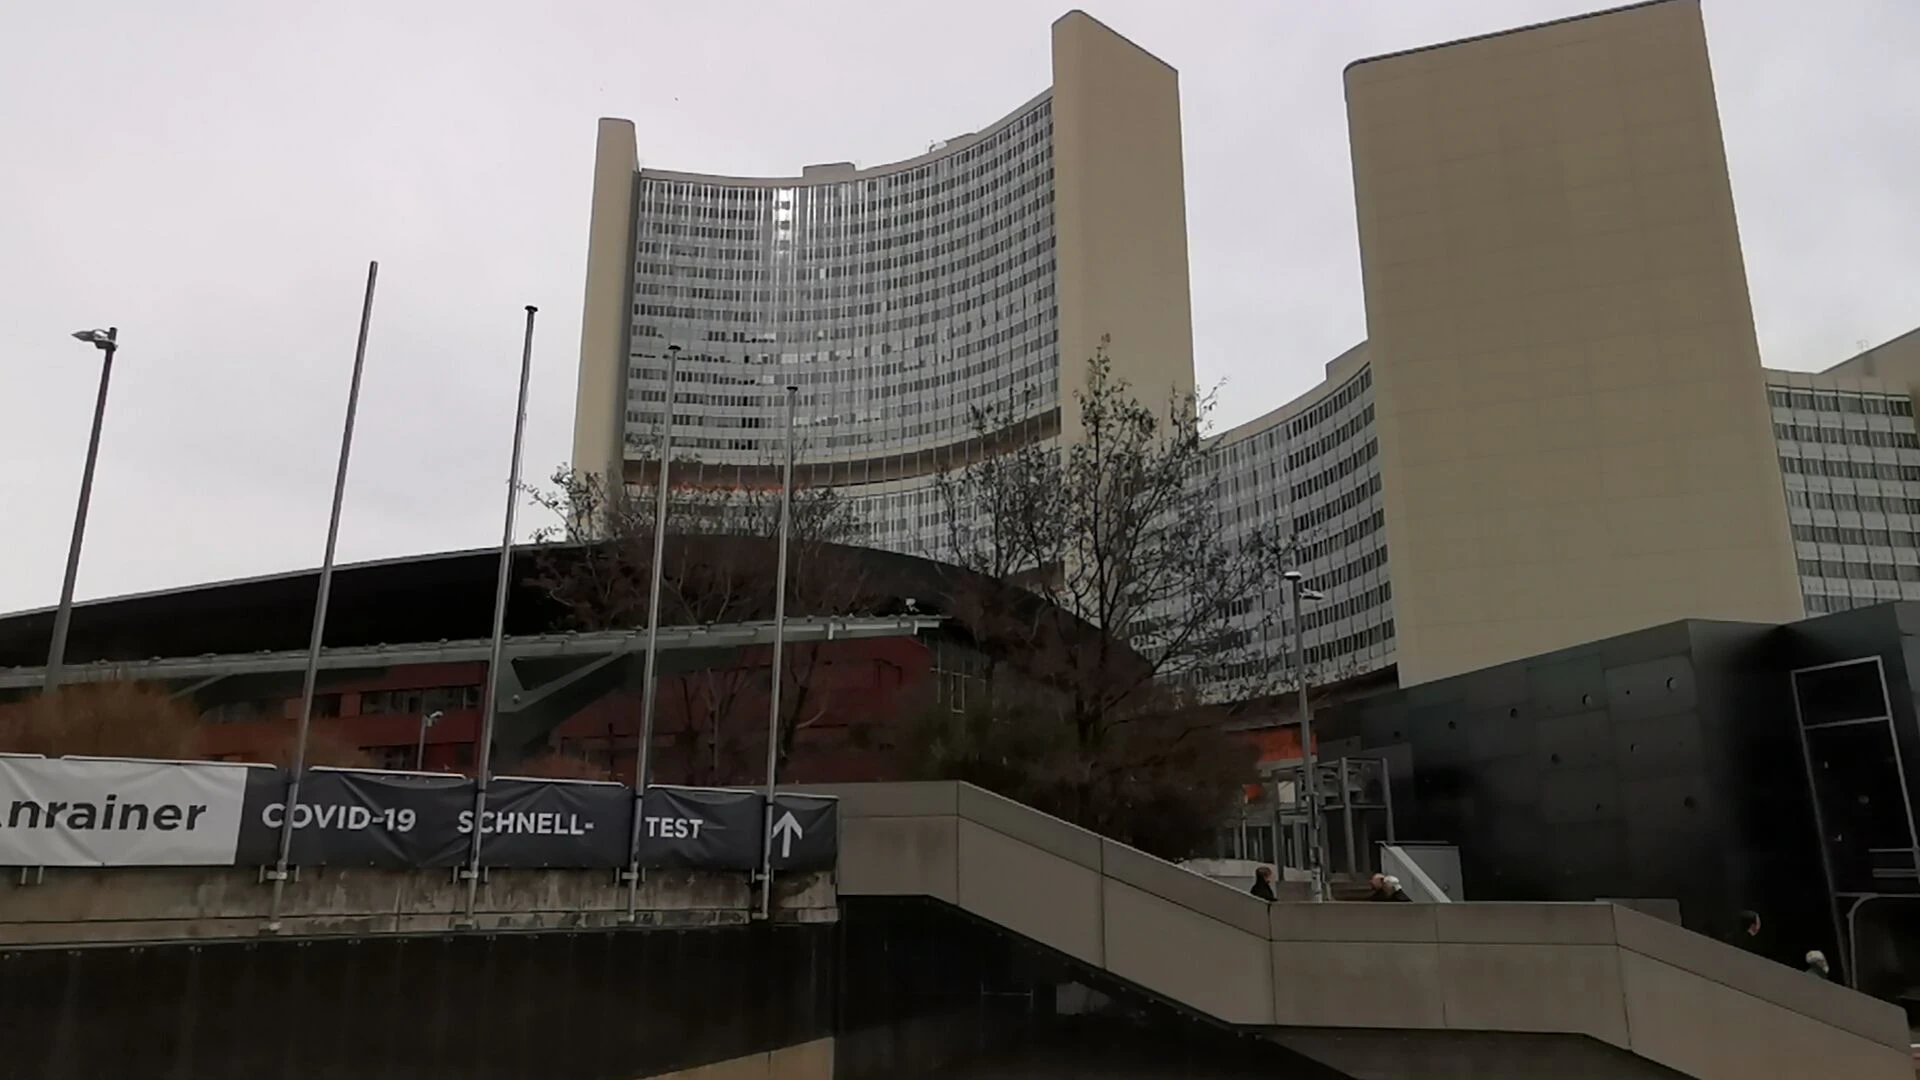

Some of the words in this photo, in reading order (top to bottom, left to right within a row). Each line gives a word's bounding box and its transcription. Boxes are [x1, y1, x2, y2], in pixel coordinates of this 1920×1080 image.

[0, 794, 207, 831] nrainer
[262, 802, 416, 832] COVID-19
[457, 811, 594, 836] SCHNELL-
[645, 817, 703, 839] TEST
